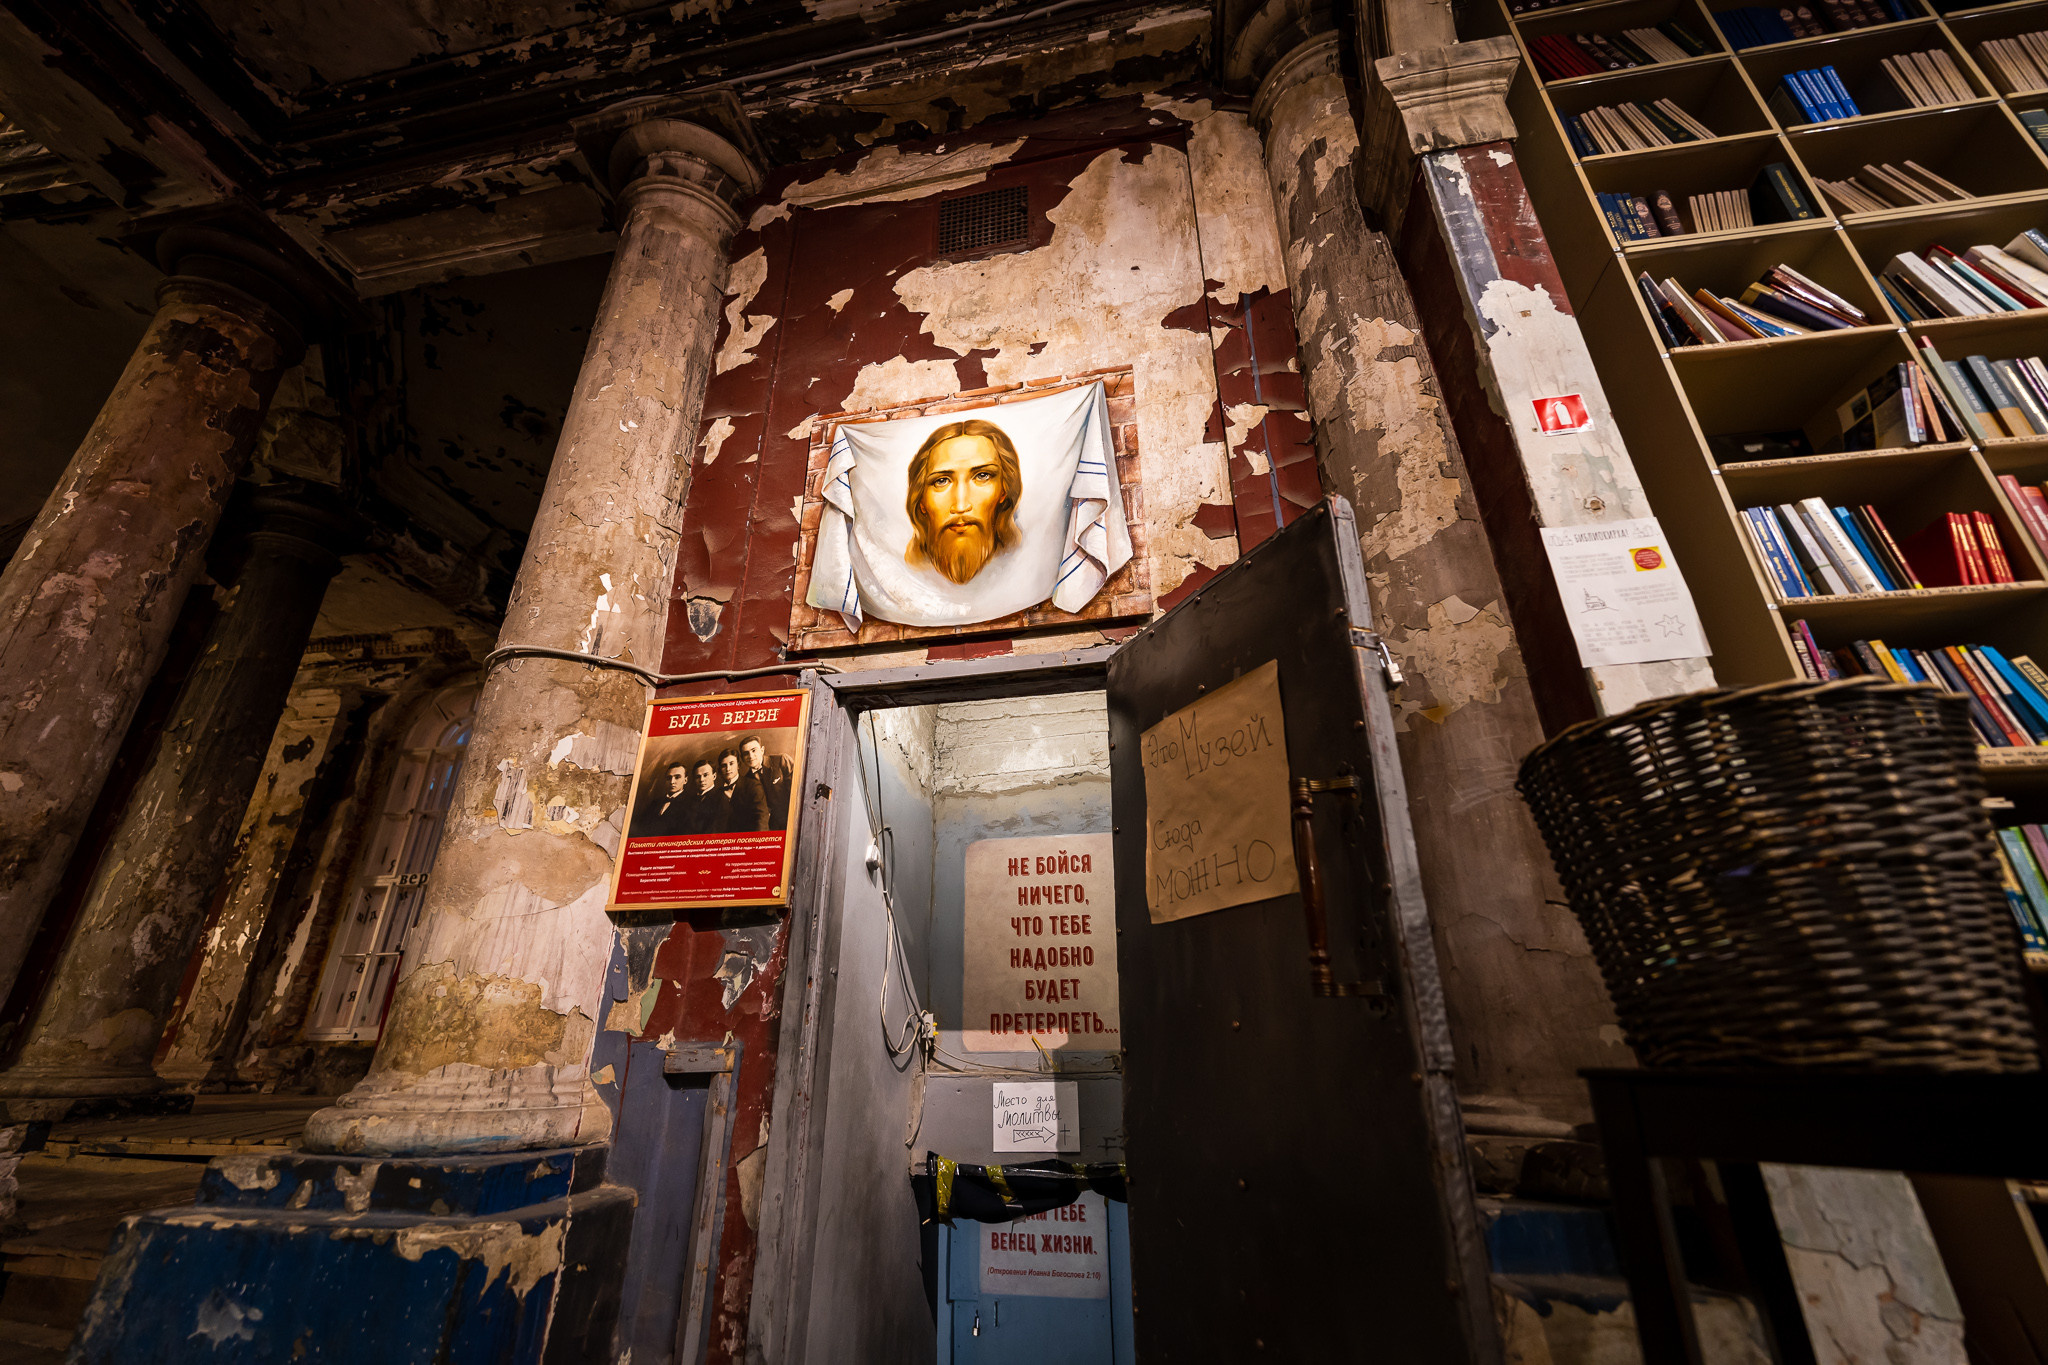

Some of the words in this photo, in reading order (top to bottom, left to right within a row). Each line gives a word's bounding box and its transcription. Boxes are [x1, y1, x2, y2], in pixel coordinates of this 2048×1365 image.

[668, 713, 711, 729] БУДЬ
[721, 708, 780, 725] ВЕРЕН
[1148, 734, 1178, 768] Это
[1178, 711, 1274, 780] Музей
[656, 839, 704, 847] ленинградских
[1153, 819, 1203, 853] Сюда
[1008, 857, 1030, 877] НЕ
[1036, 850, 1092, 875] БОЙСЯ
[1155, 839, 1276, 907] МОЖНО
[1018, 884, 1090, 906] НИЧЕГО,
[1011, 916, 1043, 936] ЧТО
[1049, 914, 1092, 935] ТЕБЕ
[1010, 945, 1094, 971] НАДОБНО
[1025, 978, 1080, 1004] БУДЕТ
[990, 1012, 1118, 1035] ПРЕТЕРПЕТЬ...
[994, 1090, 1027, 1109] Место
[1034, 1095, 1056, 1108] для
[991, 1231, 1037, 1255] ВЕНЕЦ
[1041, 1234, 1098, 1255] ЖИЗНИ.
[987, 1266, 1028, 1276] (Откровение
[1028, 1268, 1050, 1277] Иоанна
[1052, 1270, 1085, 1279] Богослова
